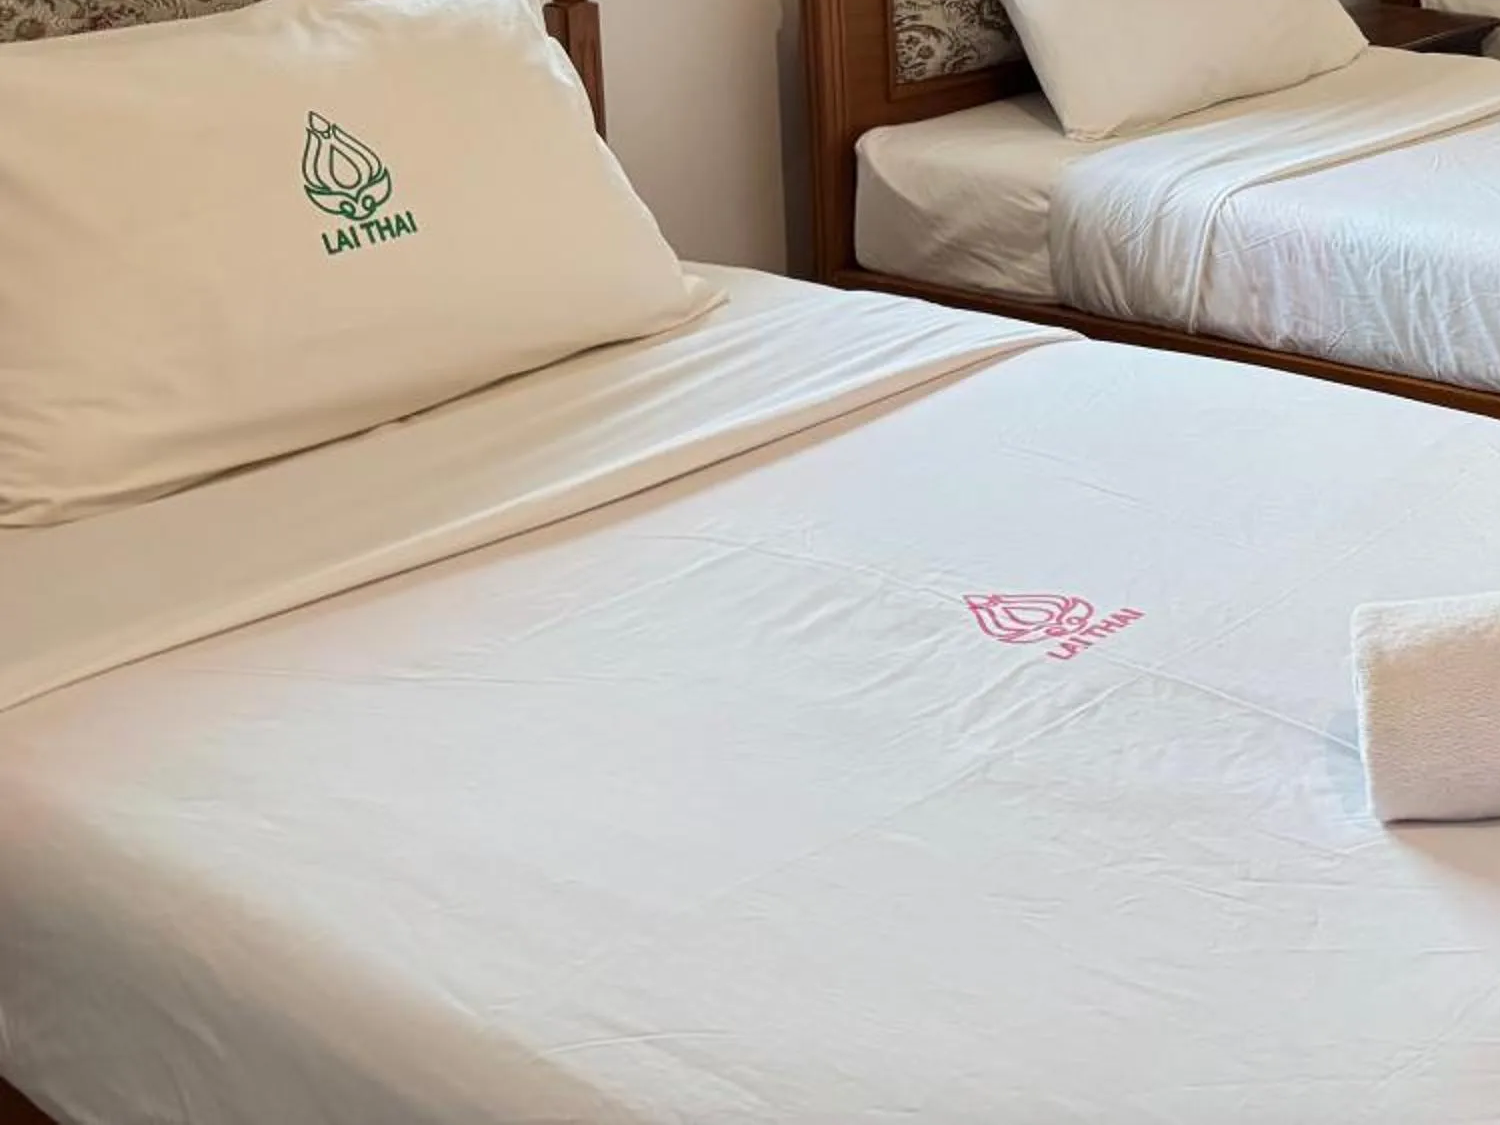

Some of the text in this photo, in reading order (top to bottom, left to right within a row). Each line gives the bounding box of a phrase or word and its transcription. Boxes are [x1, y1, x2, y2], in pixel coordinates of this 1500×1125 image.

[322, 211, 417, 255] LAI THAI
[1047, 609, 1146, 660] LAI THAI
